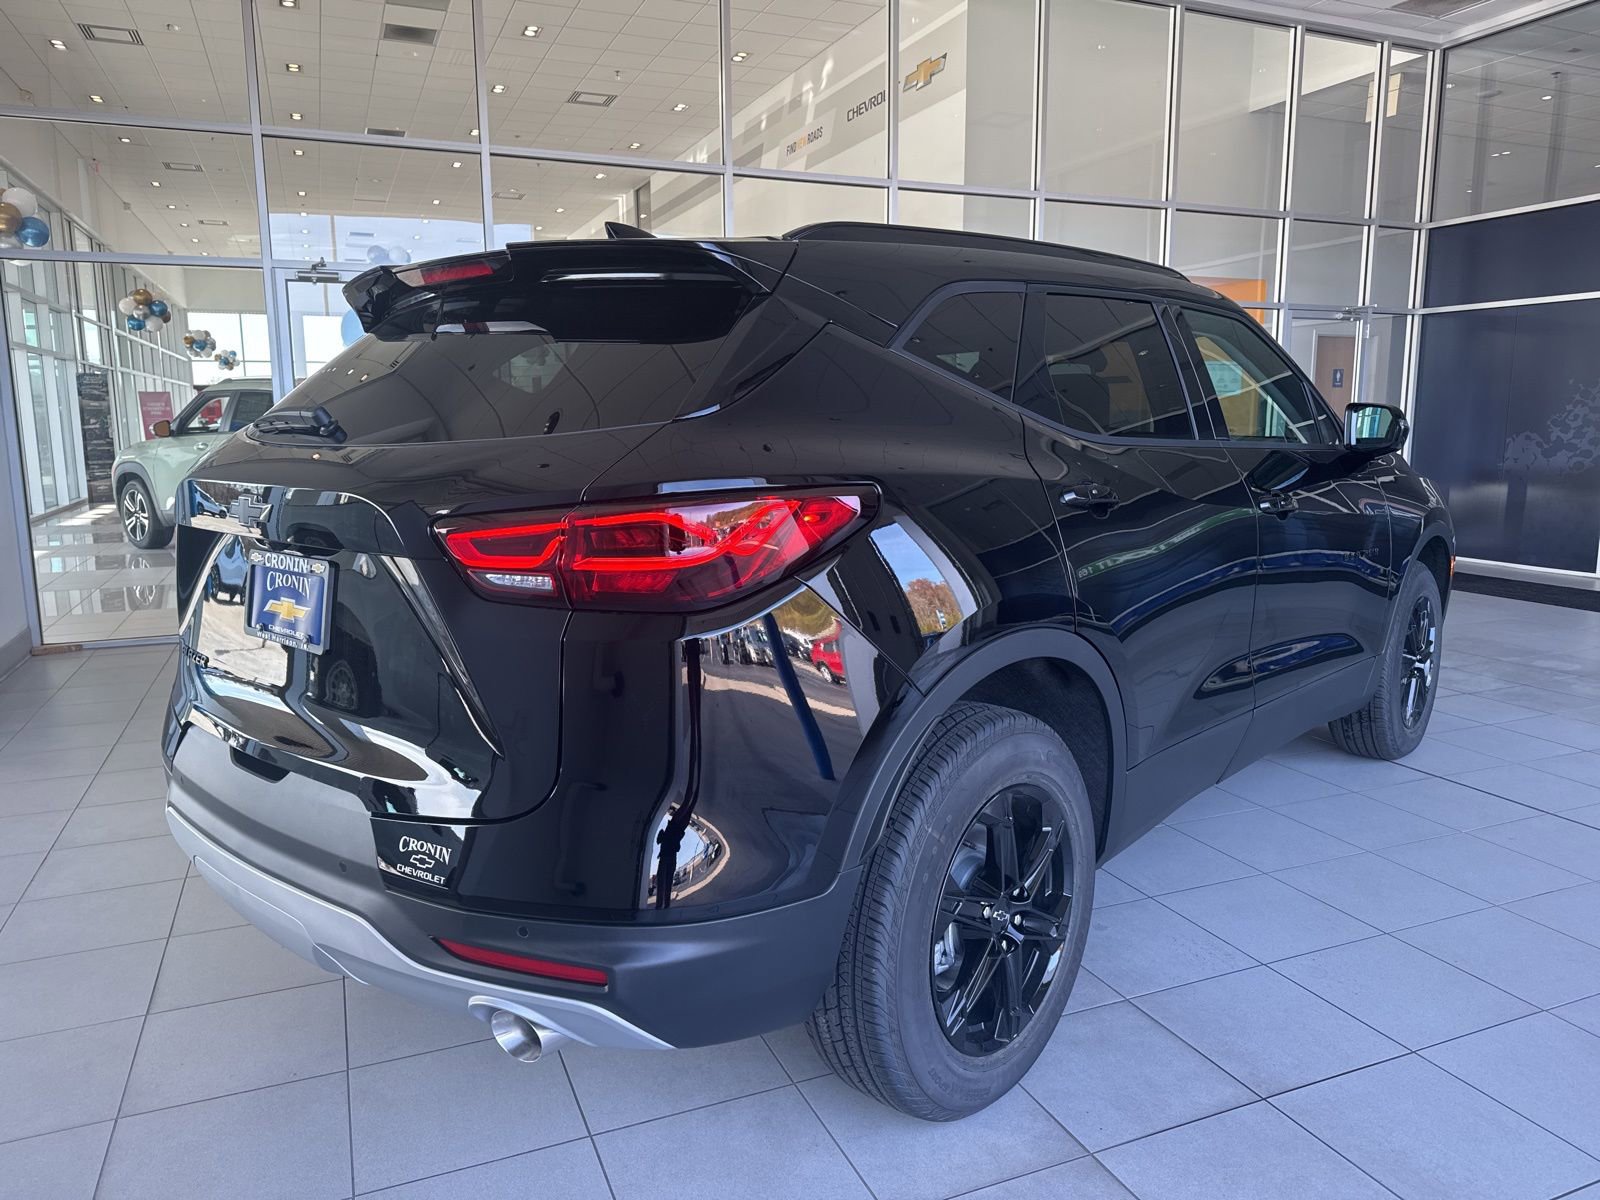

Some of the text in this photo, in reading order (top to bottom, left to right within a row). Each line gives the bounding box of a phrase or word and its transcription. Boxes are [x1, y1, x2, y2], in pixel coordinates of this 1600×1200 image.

[786, 141, 797, 157] FIND
[807, 126, 823, 145] ROADS
[265, 553, 308, 574] CRONIN
[267, 571, 311, 600] CRONIN
[399, 835, 452, 865] CRONIN
[396, 863, 446, 885] CHEVROLET
